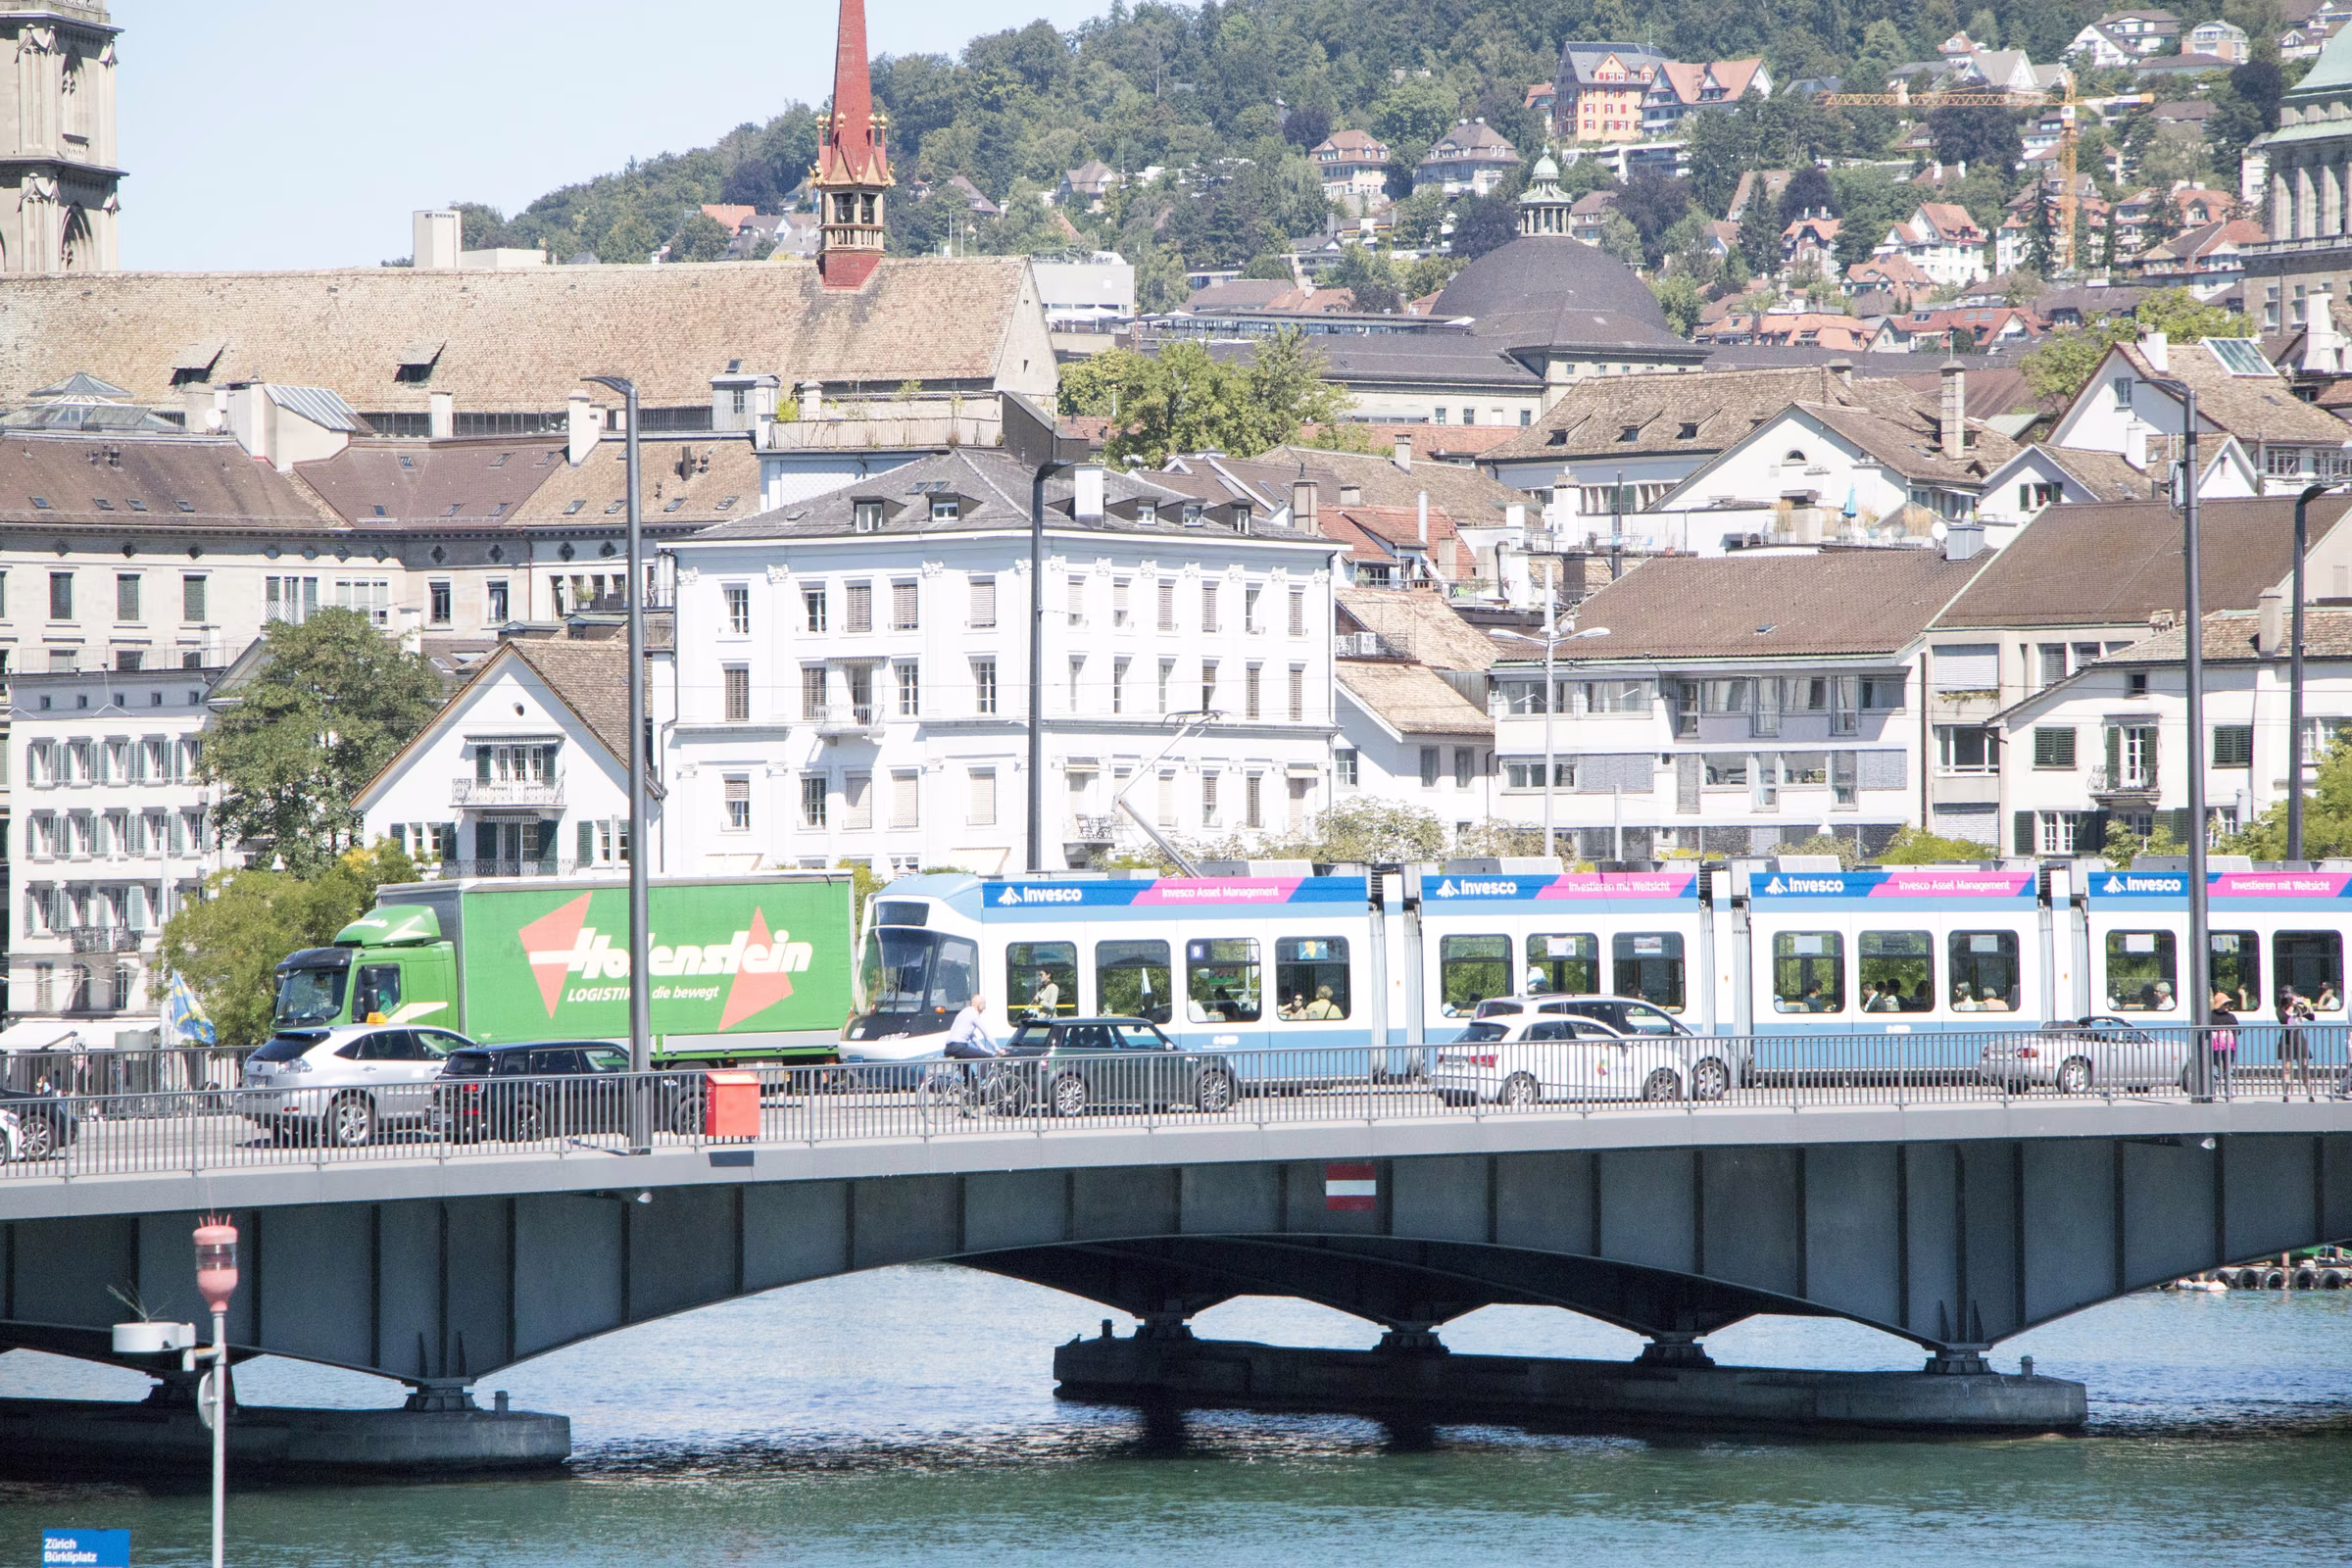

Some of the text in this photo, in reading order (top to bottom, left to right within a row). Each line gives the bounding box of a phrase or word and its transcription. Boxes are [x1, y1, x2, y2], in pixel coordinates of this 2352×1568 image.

[1460, 879, 1517, 895] Invesco
[1569, 881, 1670, 892] Investieren mit Weitsicht
[1788, 877, 1844, 893] Invesco
[1899, 880, 2010, 892] Invesco Asset Management
[2127, 876, 2181, 892] Invesco
[2231, 881, 2276, 890] Investieren
[2278, 881, 2291, 890] mit
[1023, 886, 1082, 903] Invesco
[1162, 886, 1279, 898] Invesco Asset Management
[567, 927, 813, 979] Hoenstein
[1193, 945, 1200, 956] 9
[567, 986, 719, 1002] LOGISTI die bewegt
[44, 1538, 76, 1549] Zürich
[44, 1550, 97, 1564] Bürkliplatz
